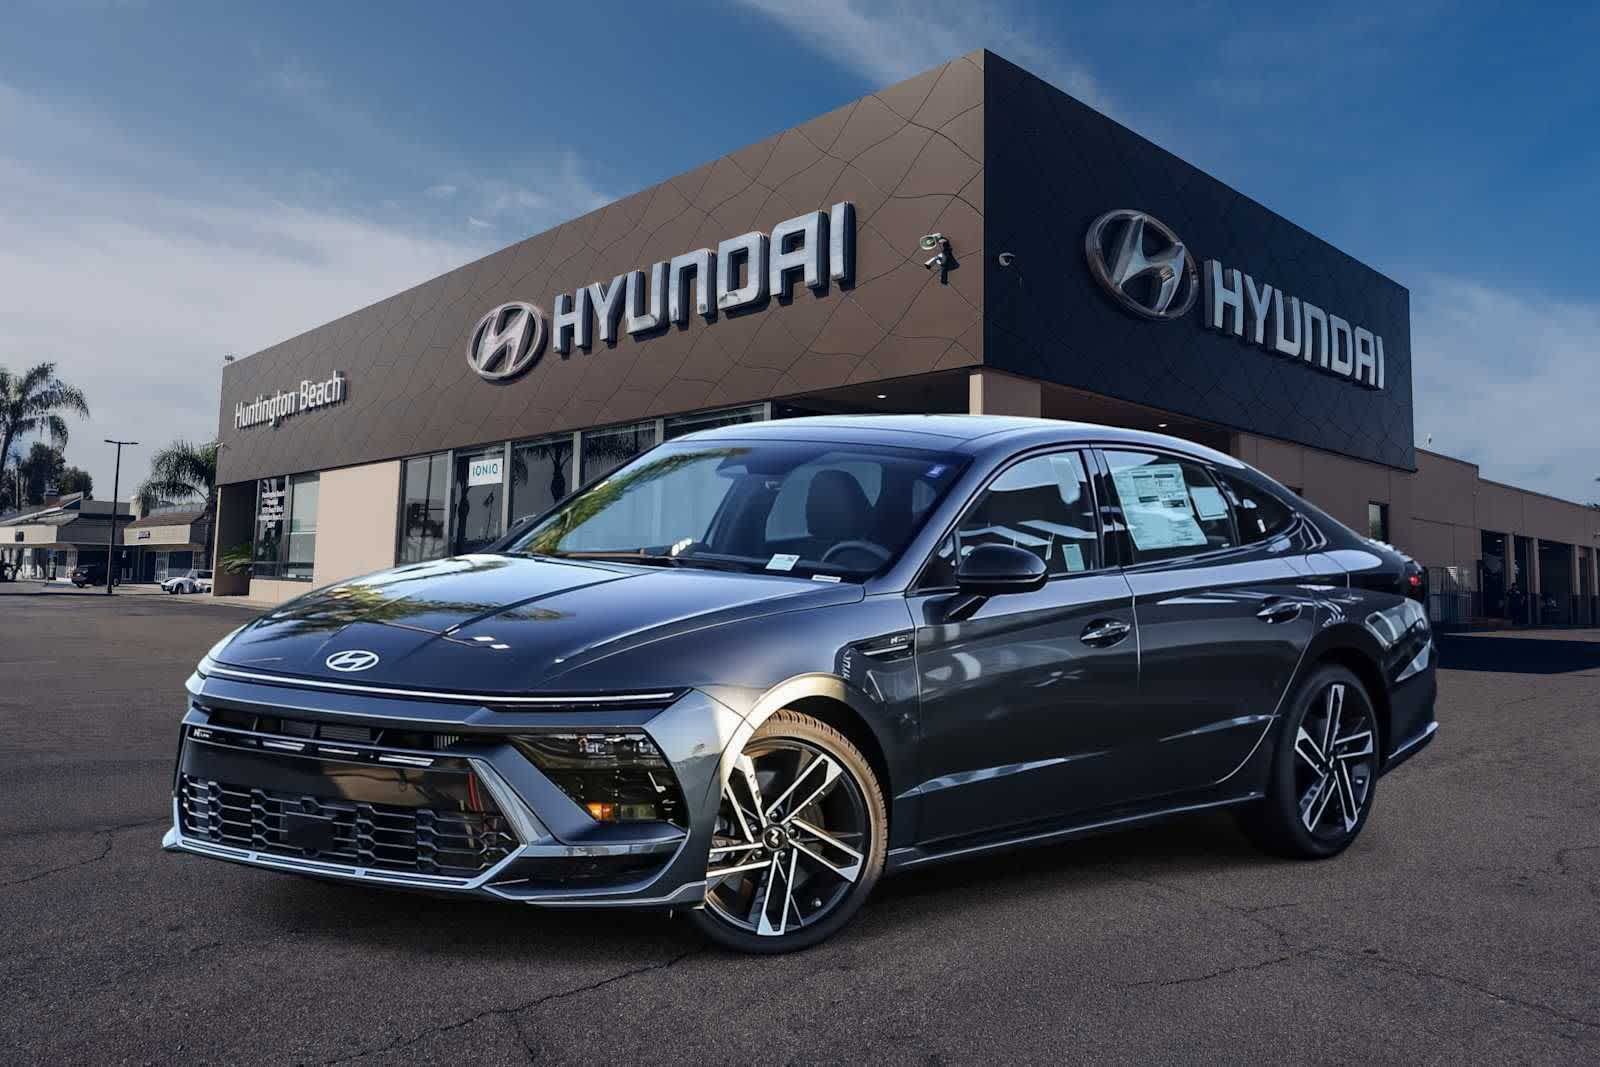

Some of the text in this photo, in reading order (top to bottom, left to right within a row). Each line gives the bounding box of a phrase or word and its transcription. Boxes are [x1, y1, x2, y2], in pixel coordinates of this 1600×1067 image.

[553, 201, 853, 353] HYUNDAI
[1207, 258, 1385, 391] HYUNDAI
[234, 370, 341, 429] Huntington Beach
